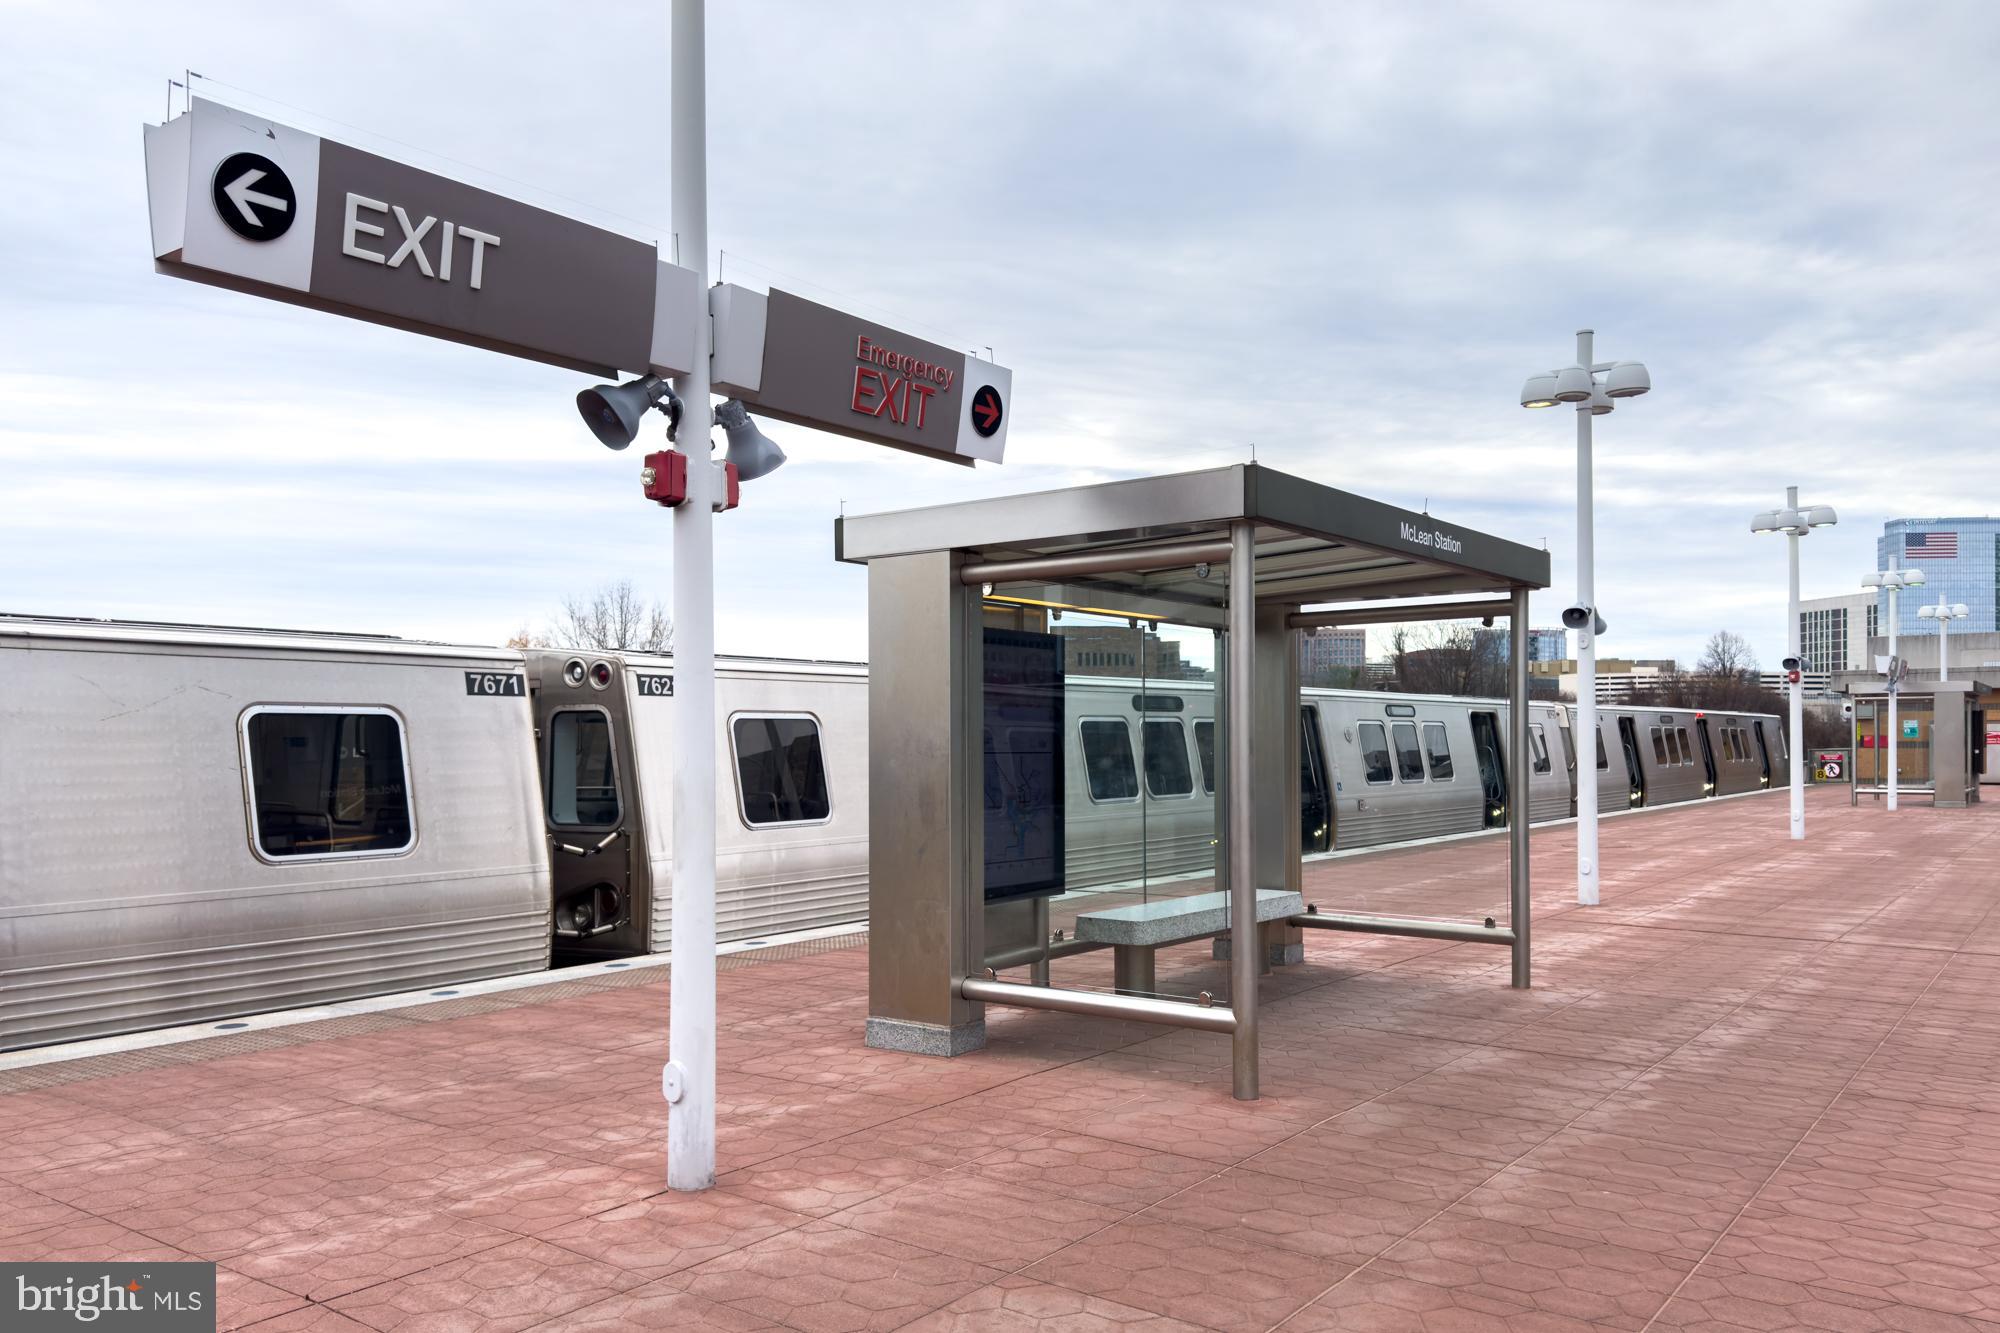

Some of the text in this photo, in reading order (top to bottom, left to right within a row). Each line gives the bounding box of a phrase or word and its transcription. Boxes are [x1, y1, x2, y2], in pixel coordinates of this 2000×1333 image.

[342, 191, 501, 290] EXIT
[856, 335, 954, 392] Emergency
[851, 365, 937, 429] EXIT
[1400, 521, 1462, 554] McLean Station
[469, 673, 519, 695] 7671
[640, 676, 674, 695] 762
